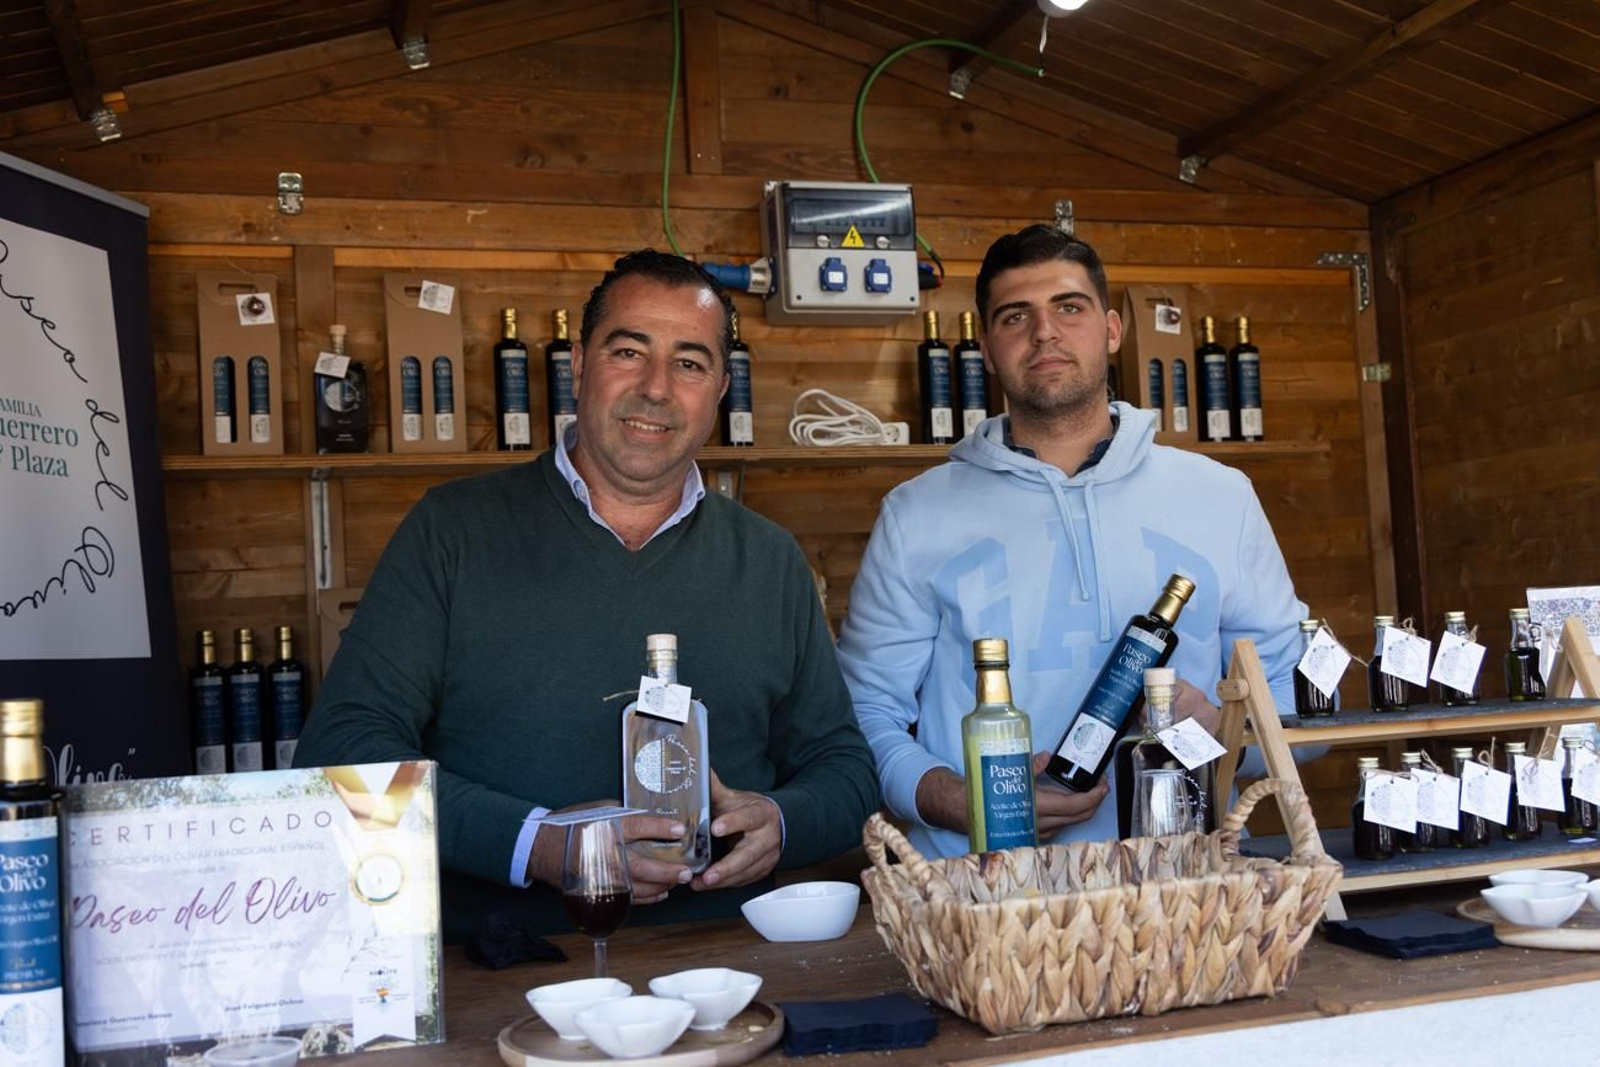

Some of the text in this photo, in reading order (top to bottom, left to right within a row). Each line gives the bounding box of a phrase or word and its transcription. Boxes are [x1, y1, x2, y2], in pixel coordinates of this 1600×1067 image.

[10, 445, 69, 478] Plaza
[85, 399, 128, 511] del
[1122, 642, 1152, 665] Paseo
[993, 779, 1026, 796] Olivo
[174, 881, 236, 932] del
[245, 876, 336, 924] Olivo
